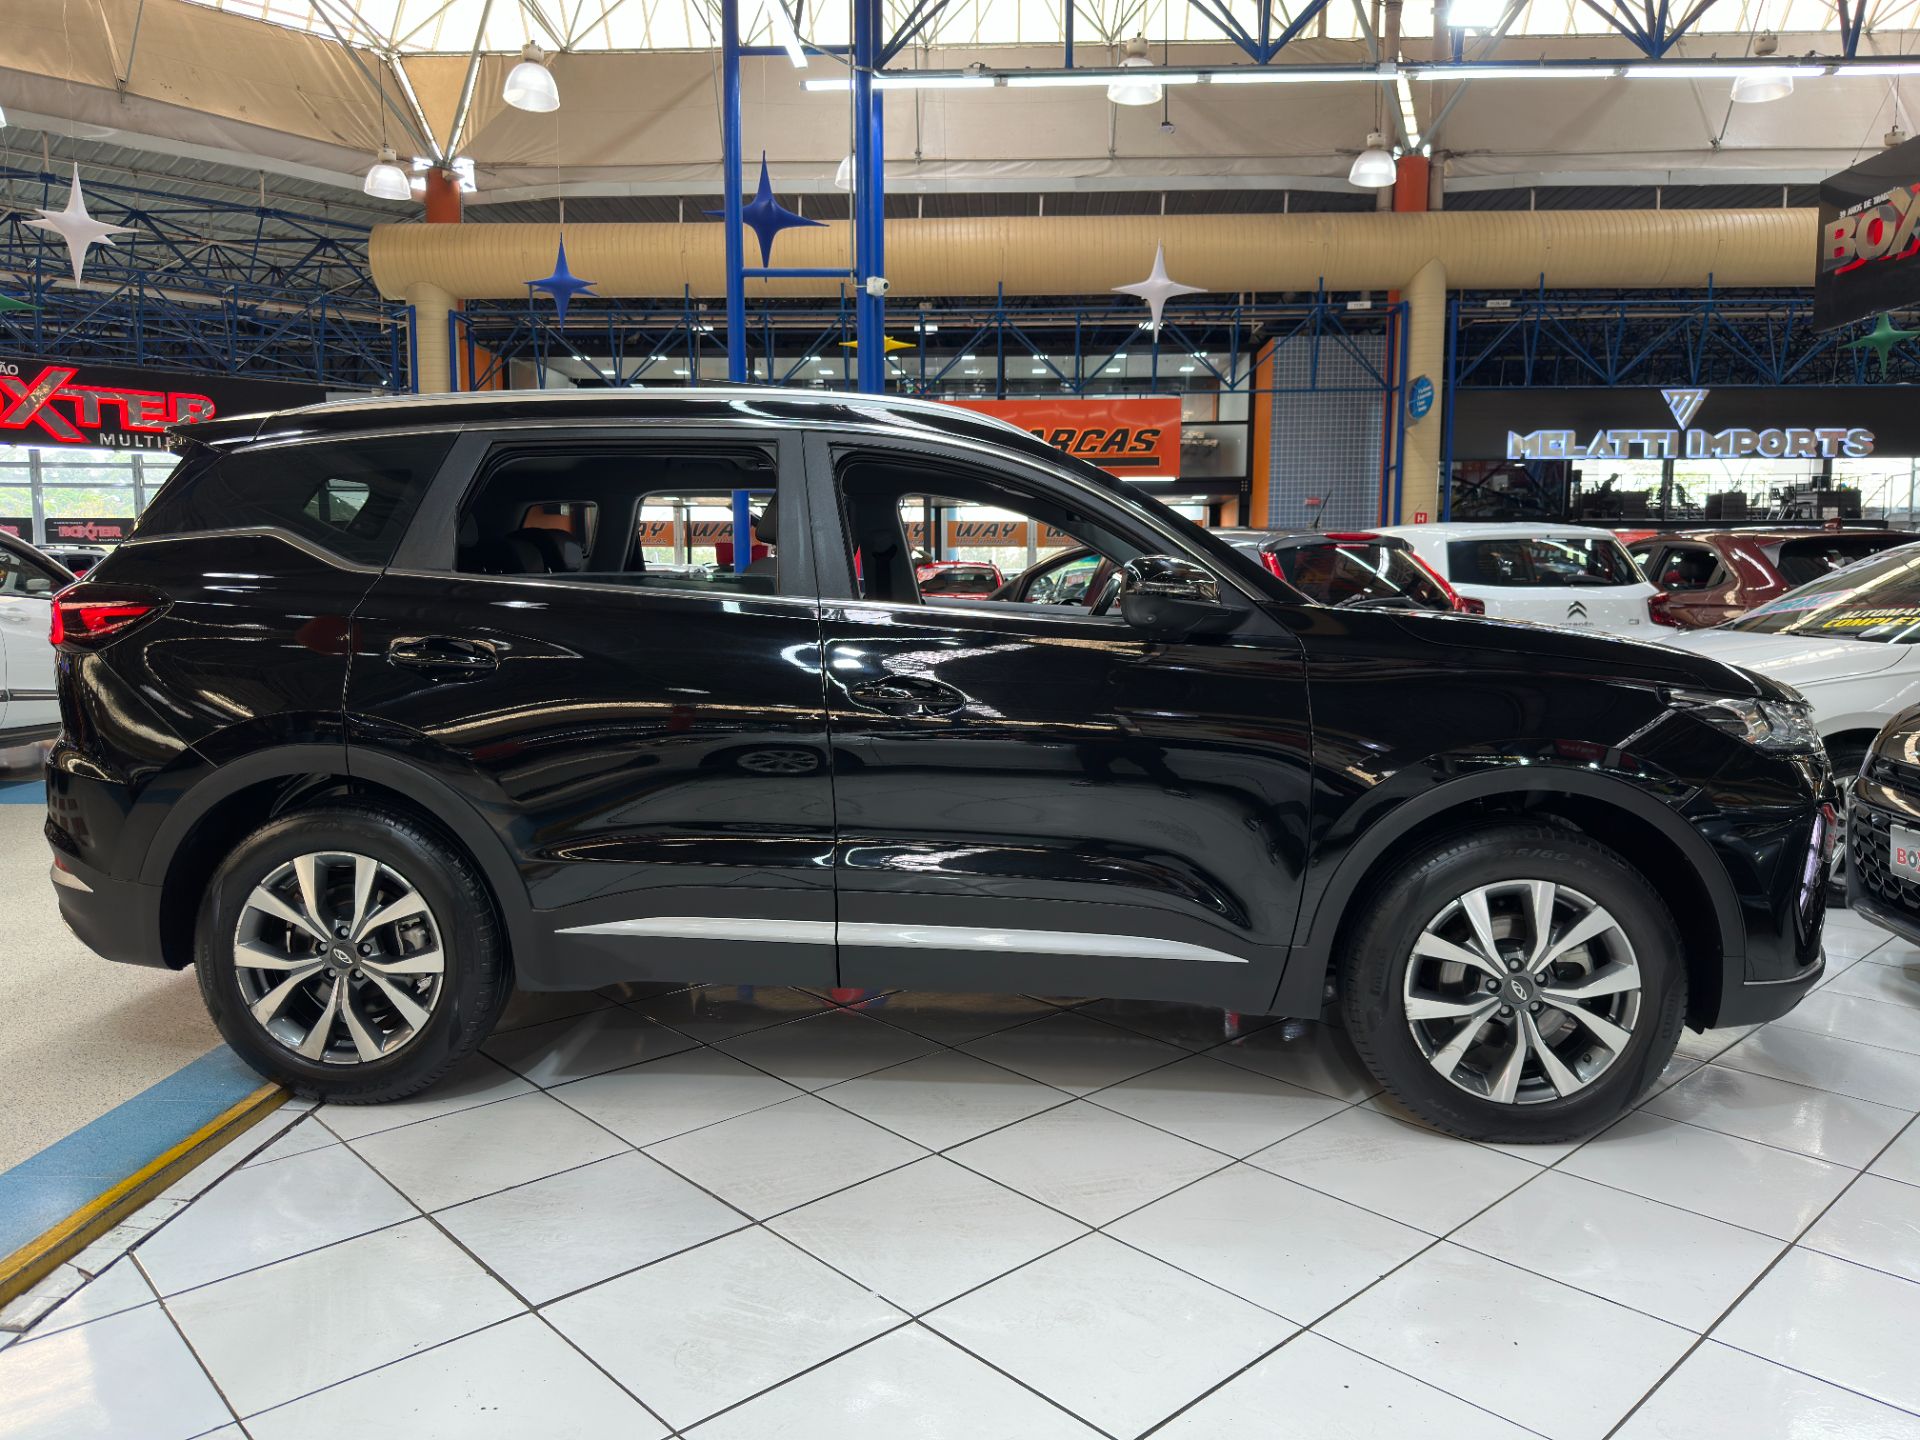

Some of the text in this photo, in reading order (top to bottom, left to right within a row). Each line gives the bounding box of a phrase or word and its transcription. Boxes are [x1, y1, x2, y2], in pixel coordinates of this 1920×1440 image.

[1863, 198, 1873, 210] DE
[1507, 428, 1876, 460] MELATTI IMPORTS
[956, 523, 1017, 538] WAY
[1896, 847, 1920, 873] BO
